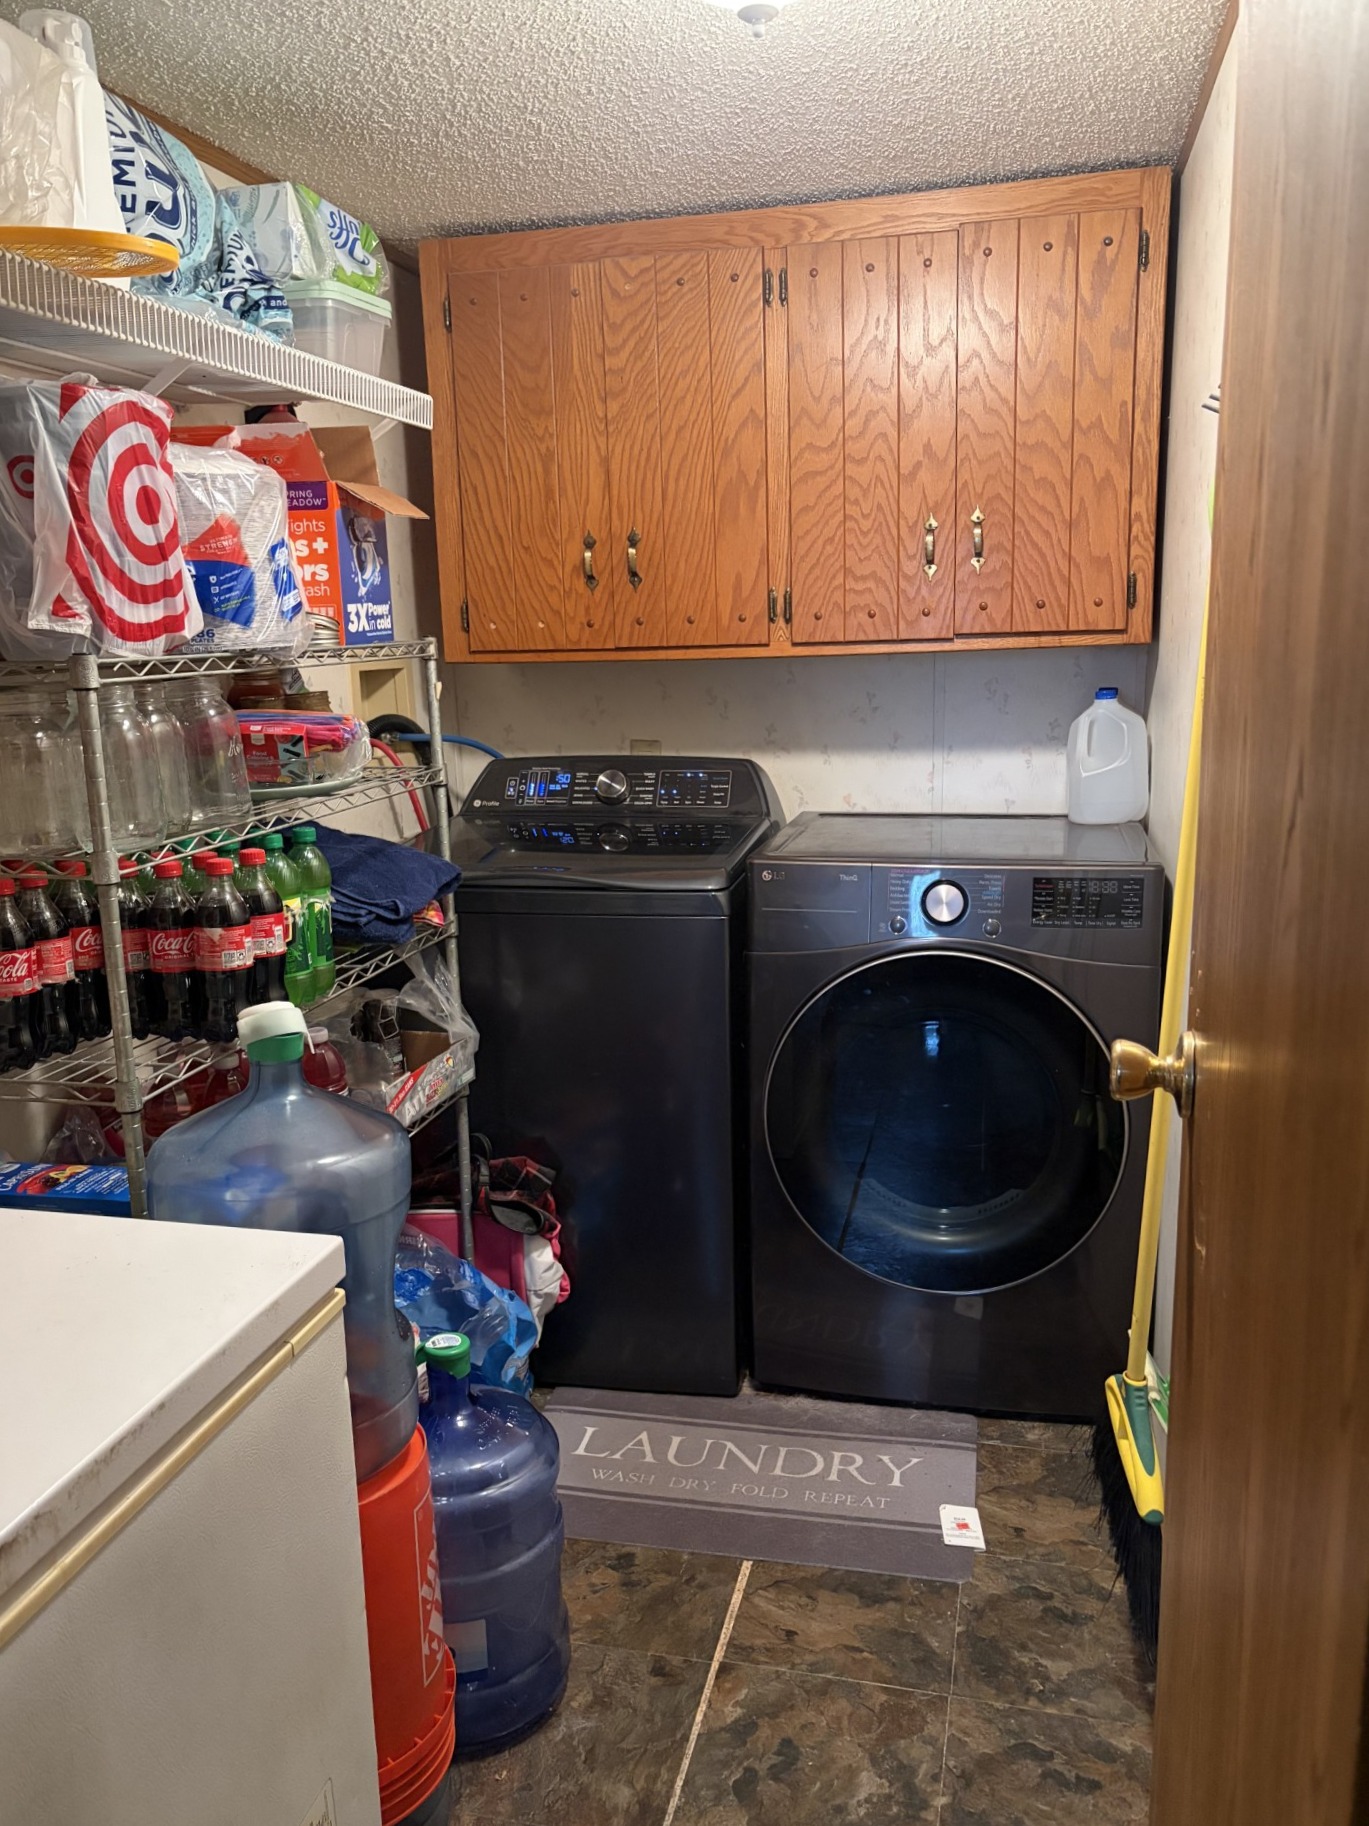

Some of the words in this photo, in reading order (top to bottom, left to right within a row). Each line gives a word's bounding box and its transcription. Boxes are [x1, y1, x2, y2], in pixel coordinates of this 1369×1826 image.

[287, 490, 313, 499] RING
[289, 519, 326, 535] ights
[304, 582, 331, 597] ash
[368, 602, 389, 616] Power
[346, 602, 370, 633] 3X
[369, 617, 376, 630] in
[376, 614, 392, 630] cold
[570, 1426, 924, 1488] LAUNDRY
[591, 1467, 656, 1486] WASH
[668, 1475, 716, 1492] DRY
[730, 1482, 789, 1500] FOLD
[803, 1489, 891, 1509] REPEAT
